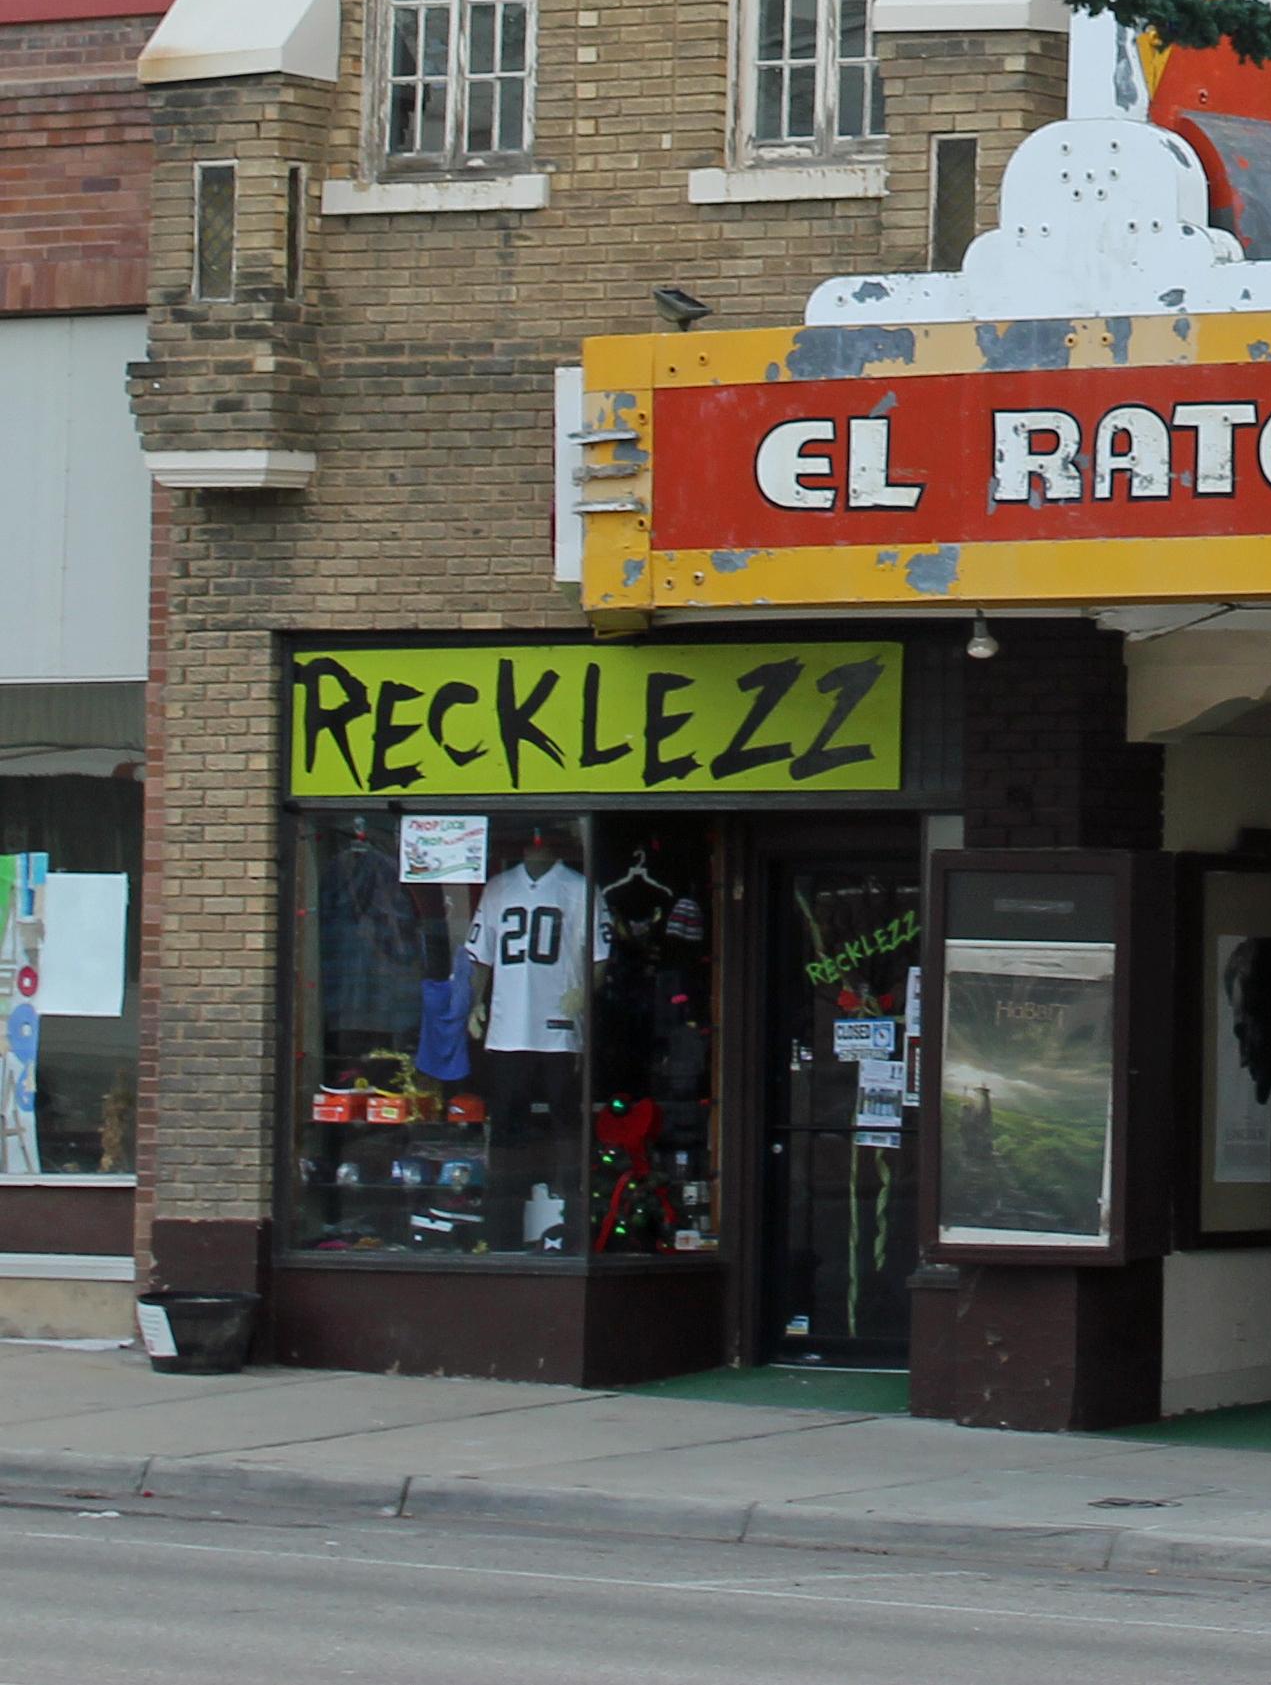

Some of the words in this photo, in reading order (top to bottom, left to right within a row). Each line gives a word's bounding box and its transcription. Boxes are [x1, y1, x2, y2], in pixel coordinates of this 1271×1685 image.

[756, 416, 926, 512] EL
[293, 655, 888, 793] RECKLEZZ
[501, 906, 564, 966] 20
[806, 910, 921, 986] RECKLEZZ
